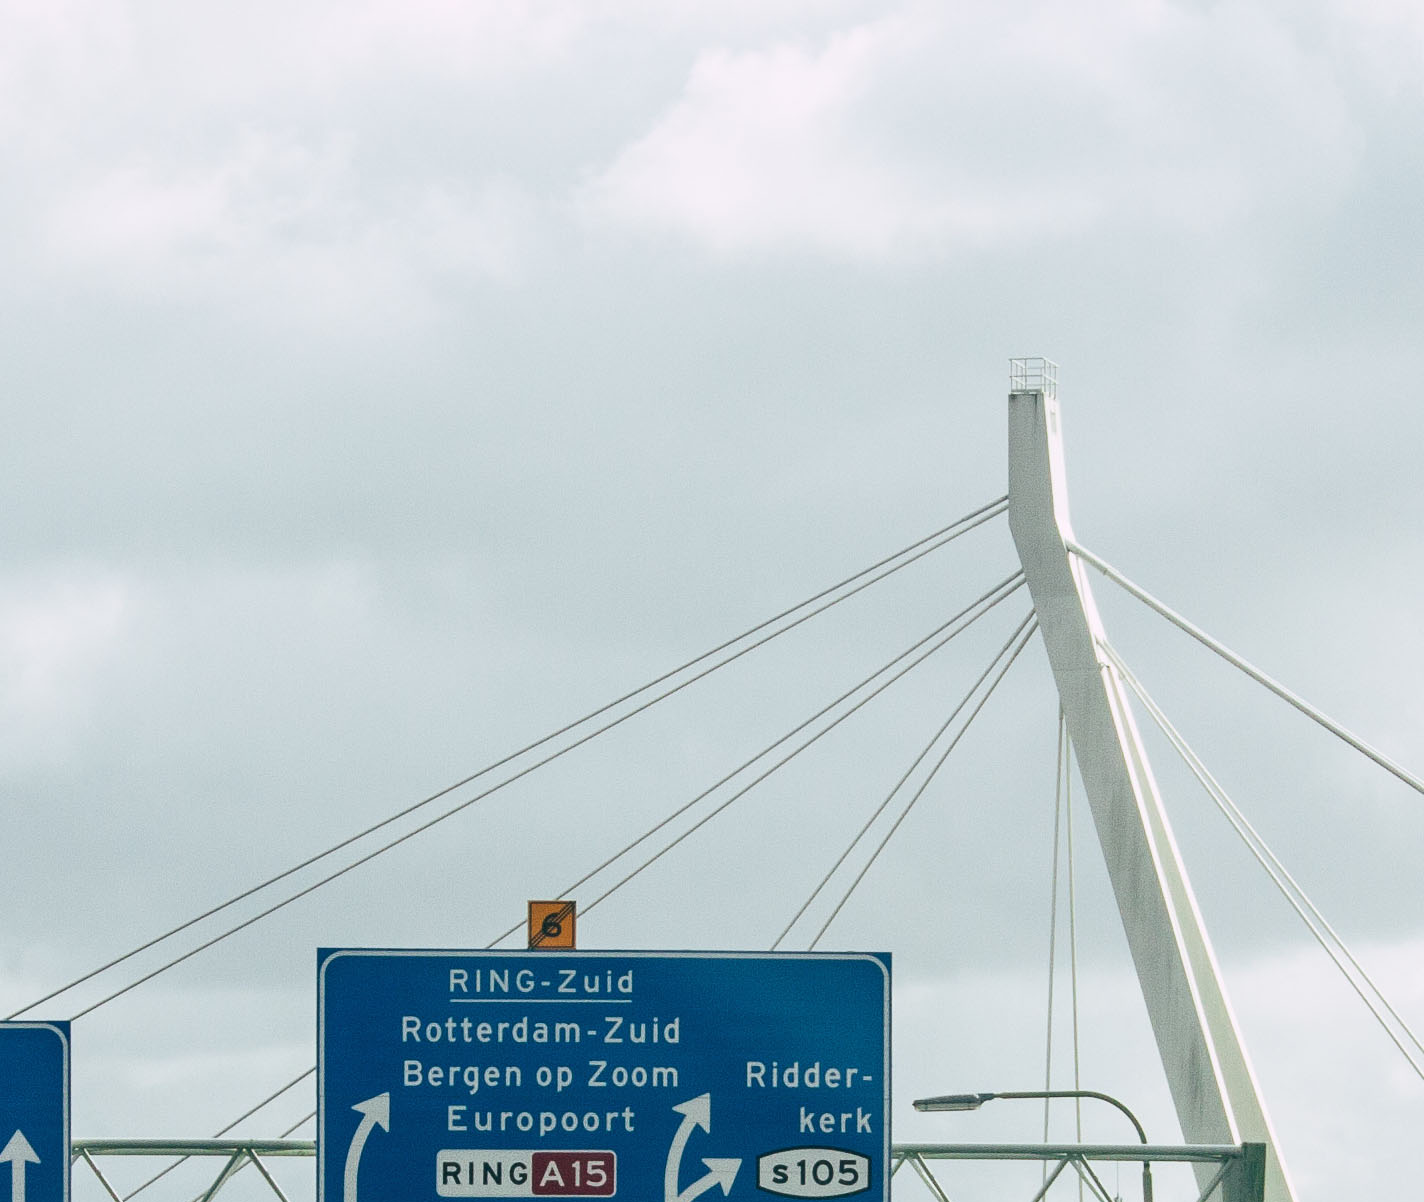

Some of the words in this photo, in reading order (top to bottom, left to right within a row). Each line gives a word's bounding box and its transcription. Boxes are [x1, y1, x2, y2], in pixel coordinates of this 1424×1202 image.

[449, 968, 633, 993] RING-Zuid
[402, 1015, 680, 1044] Rotterdam-Zuid
[403, 1059, 522, 1095] Bergen
[536, 1066, 573, 1091] op
[588, 1060, 678, 1087] Zoom
[746, 1061, 873, 1088] Ridder-
[447, 1105, 635, 1137] Europoort
[799, 1106, 872, 1133] kerk
[442, 1161, 528, 1186] RING
[539, 1160, 607, 1188] A15
[771, 1159, 860, 1186] s105
